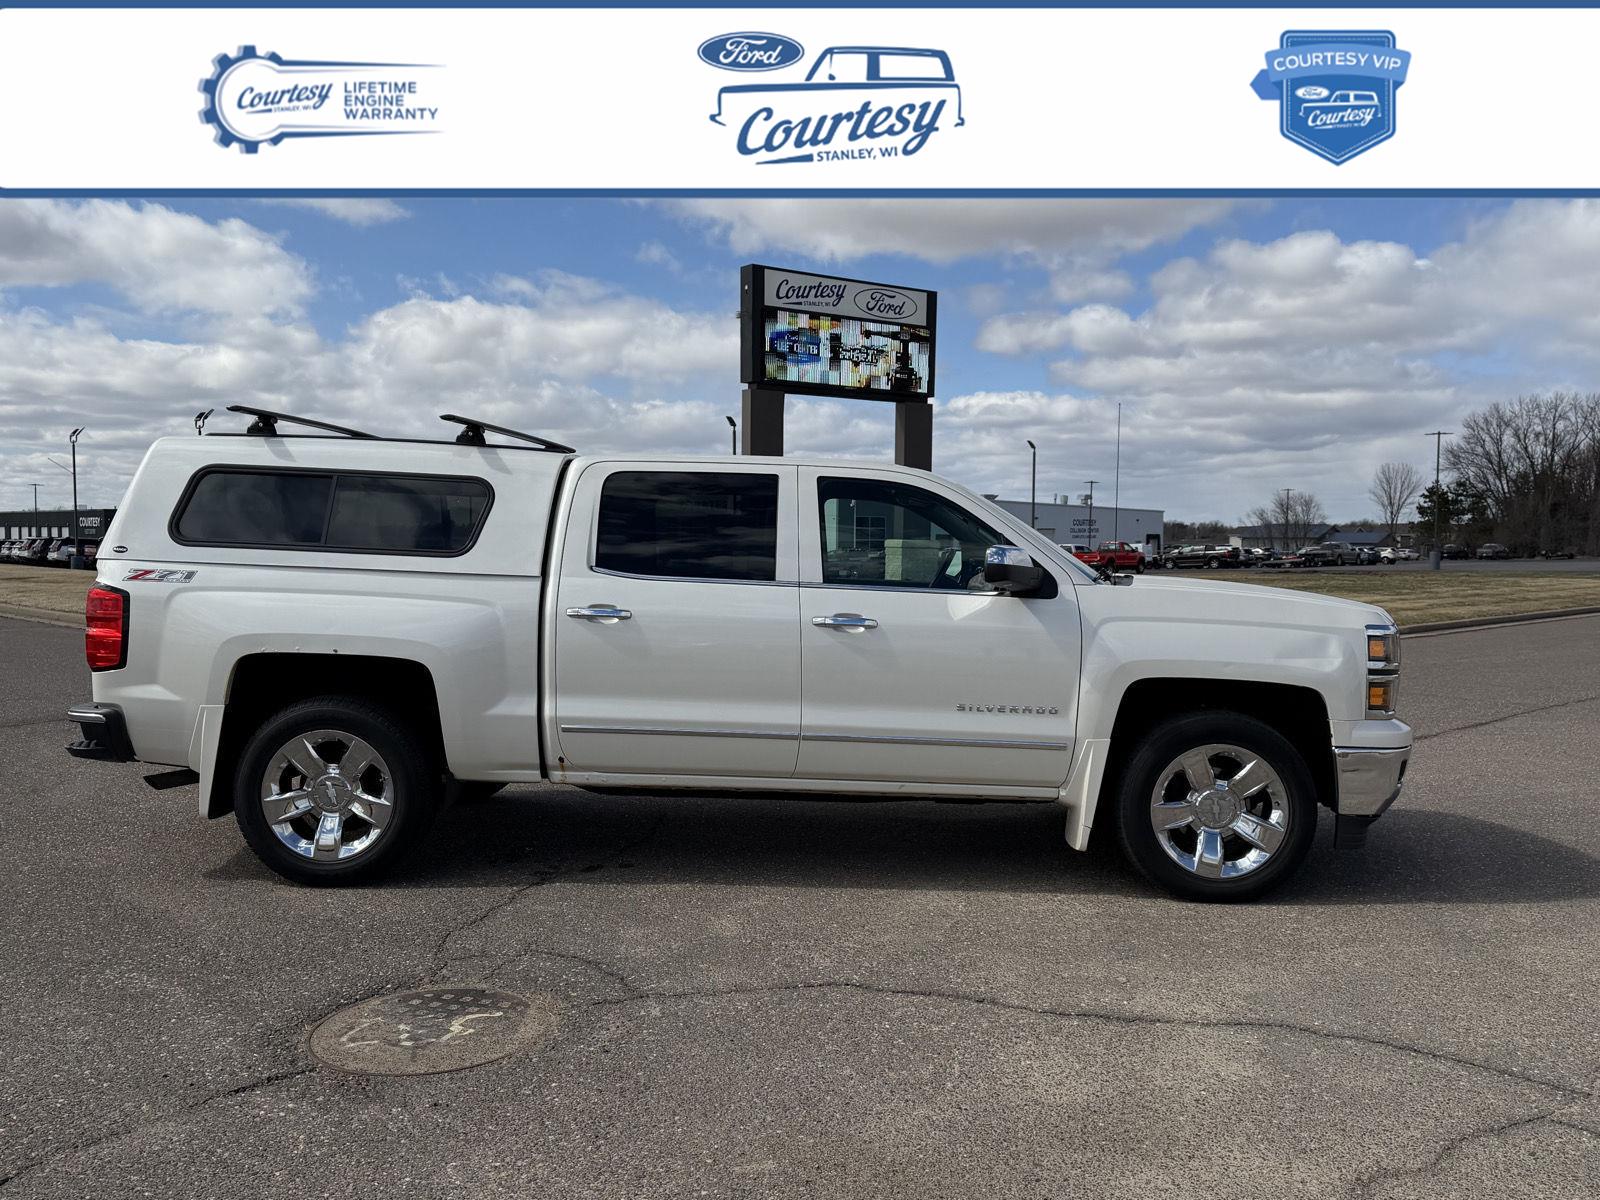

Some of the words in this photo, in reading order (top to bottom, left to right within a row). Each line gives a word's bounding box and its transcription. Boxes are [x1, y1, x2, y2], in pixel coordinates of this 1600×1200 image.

[776, 279, 846, 307] Courtesy
[866, 291, 906, 316] Ford
[79, 517, 100, 527] COURTESY
[122, 568, 198, 583] Z71
[956, 703, 1059, 715] SILVERADO
